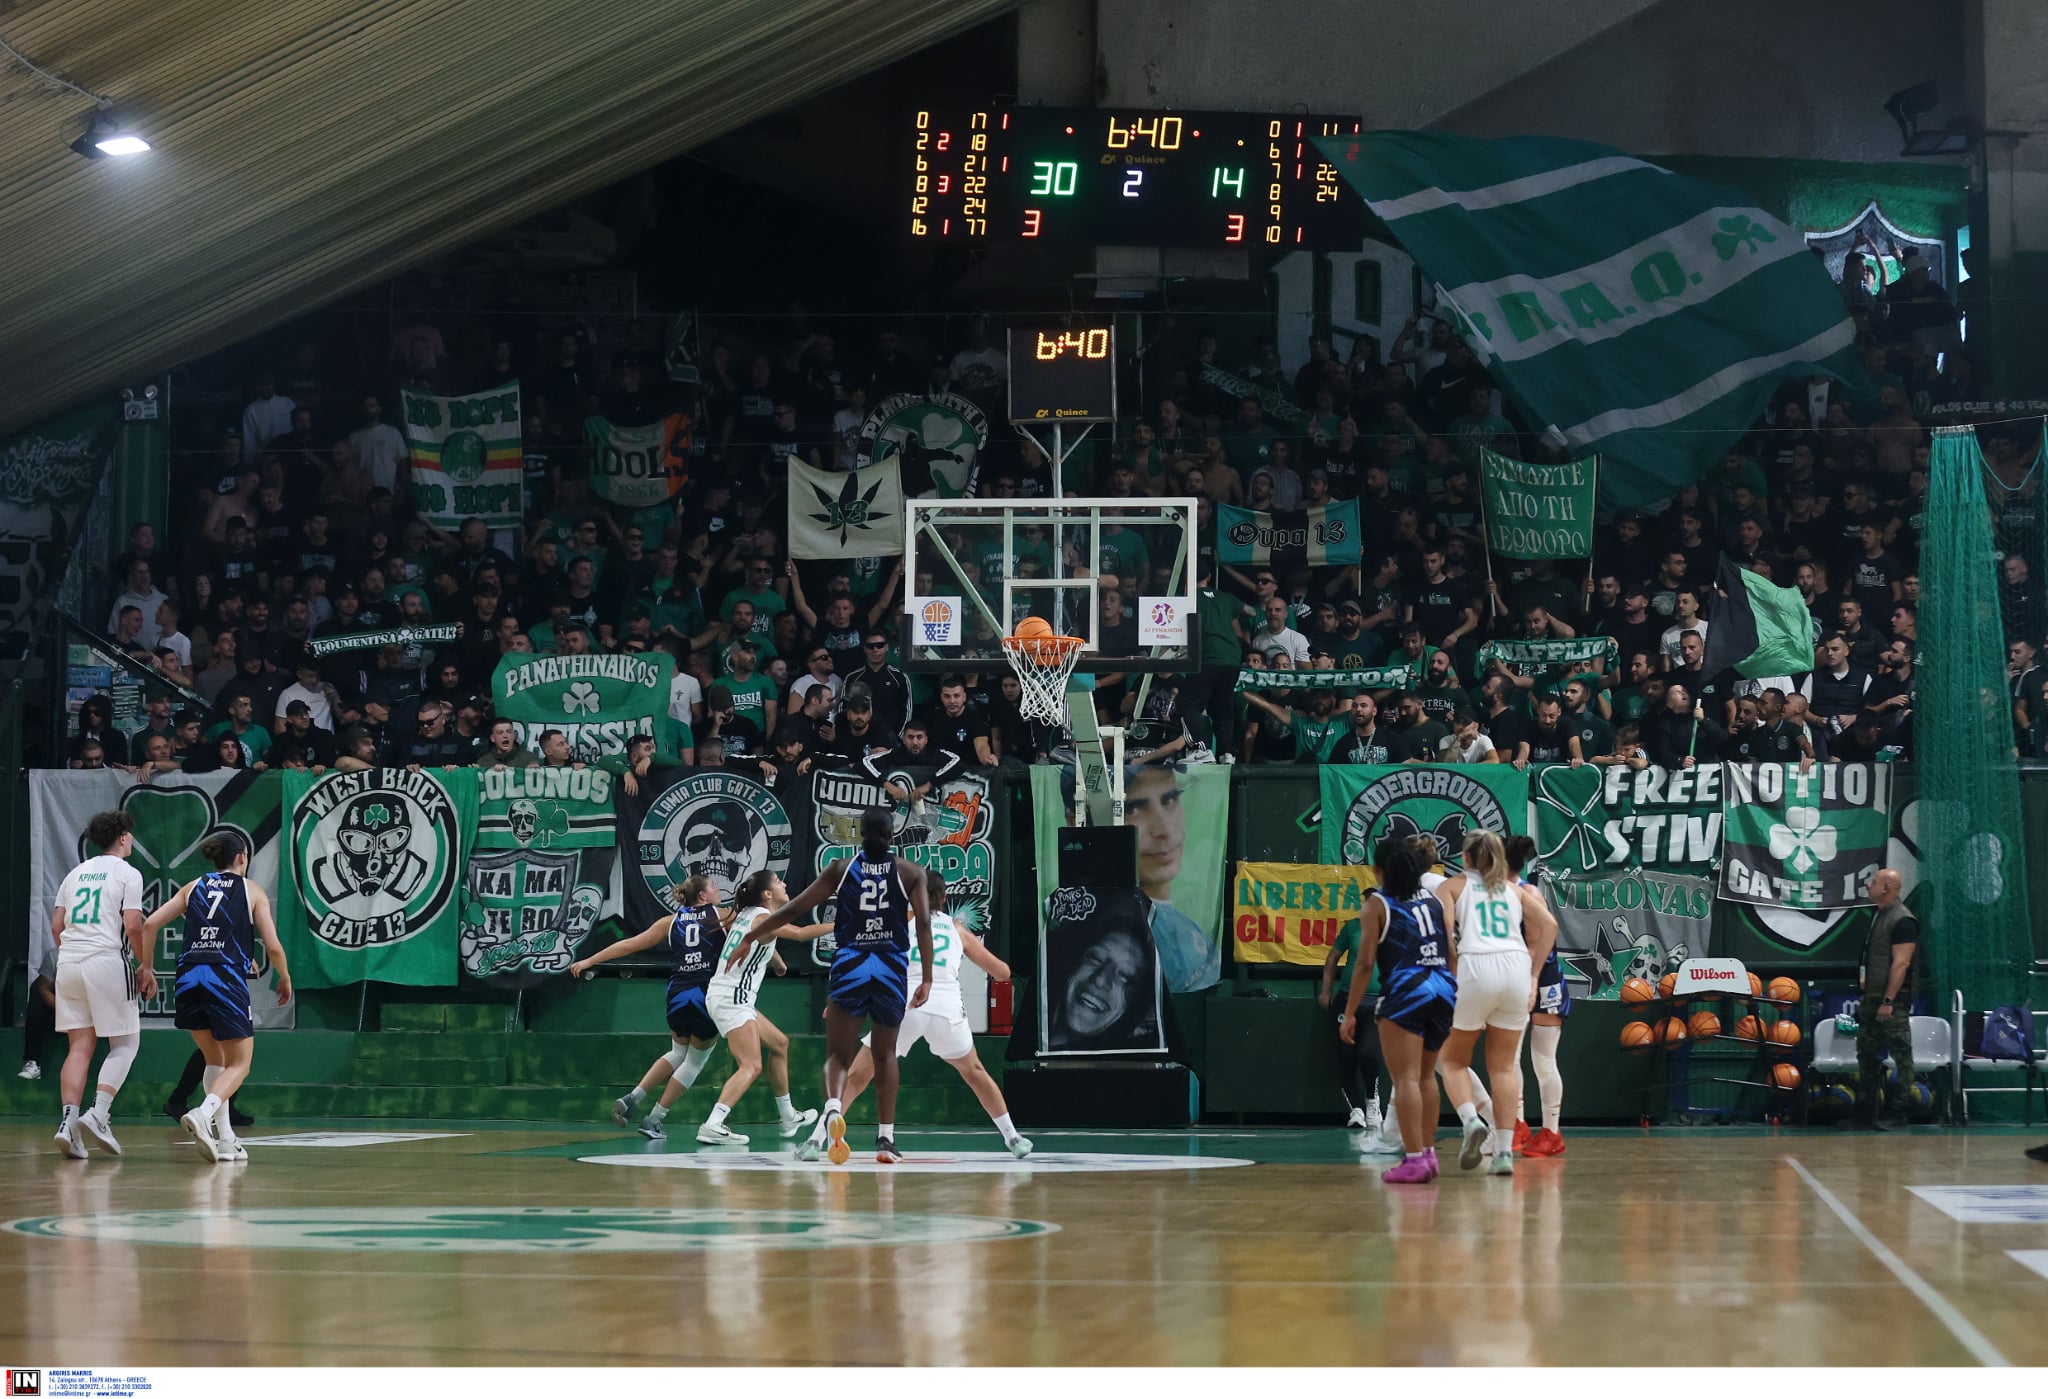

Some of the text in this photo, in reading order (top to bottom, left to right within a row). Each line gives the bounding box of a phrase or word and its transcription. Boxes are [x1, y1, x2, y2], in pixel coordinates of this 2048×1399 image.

[916, 112, 1008, 130] 0 17 1
[1107, 116, 1183, 150] 6:40
[1269, 120, 1281, 138] 0
[1296, 122, 1302, 138] 1
[1322, 122, 1339, 137] 11
[916, 133, 987, 150] 2 2 18
[1269, 142, 1281, 159] 6
[1296, 142, 1302, 159] 1
[916, 155, 1008, 172] 6 21 1
[1125, 153, 1167, 165] Quince
[1271, 162, 1281, 180] 7
[1296, 163, 1302, 180] 1
[916, 176, 987, 193] 8 3 22
[1030, 162, 1244, 198] 30 2 14
[1269, 183, 1339, 202] 8 24
[912, 197, 986, 214] 12 24
[1270, 204, 1281, 221] 9
[911, 219, 986, 236] 16 1 77
[1021, 209, 1243, 241] 3 3
[1266, 225, 1302, 242] 10 1
[1036, 328, 1109, 359] 6:40
[407, 398, 442, 426] NO
[1055, 407, 1089, 417] Quince
[1497, 490, 1576, 520] ΑΠΟ ΤΗ
[1314, 519, 1346, 546] 13
[505, 654, 659, 698] PANATHINAIKOS
[306, 767, 446, 825] WEST BLOCK
[653, 777, 777, 819] LAMIA CLUB GATE 13
[1604, 763, 1722, 806] FREE
[1347, 771, 1506, 840] UNDERGROUND
[640, 839, 791, 861] 19 94
[479, 868, 563, 896] KA MA
[859, 879, 890, 911] 22
[1238, 878, 1362, 911] LIBERTÀ
[1728, 858, 1824, 903] GATE
[71, 886, 103, 925] 21
[207, 890, 224, 920] 7
[1549, 877, 1711, 920] VIRONAS
[319, 911, 406, 945] GATE 13
[1237, 914, 1286, 944] GLI
[1411, 903, 1436, 938] 11
[1475, 901, 1509, 938] 16
[685, 923, 700, 947] 0
[1690, 967, 1736, 980] Wilson
